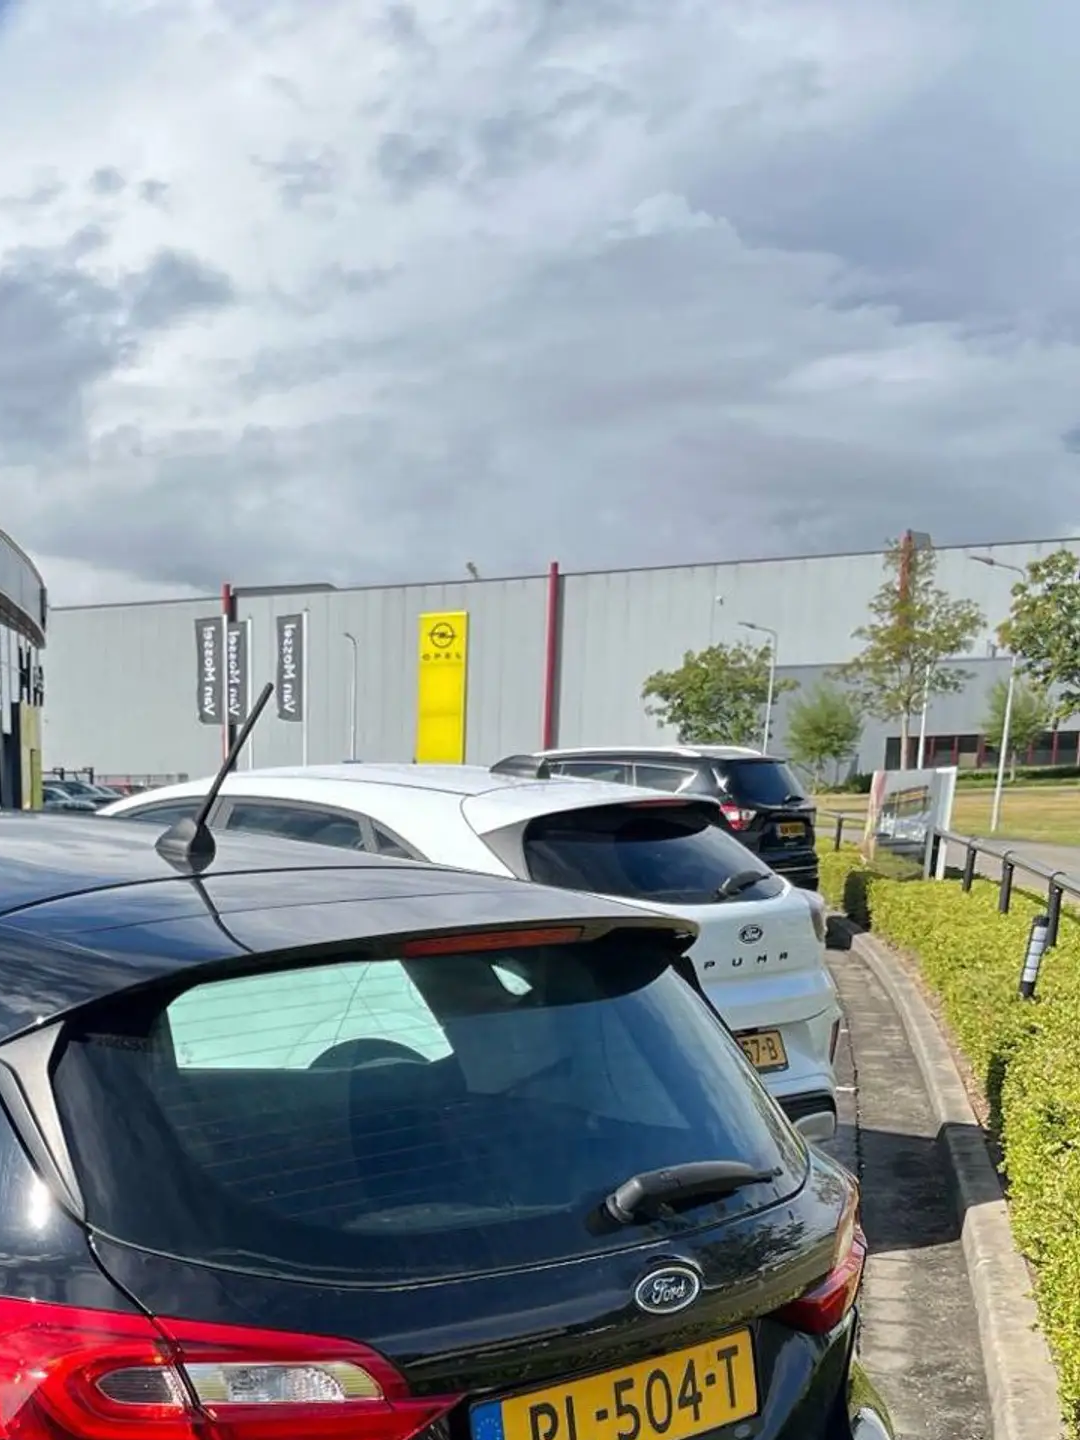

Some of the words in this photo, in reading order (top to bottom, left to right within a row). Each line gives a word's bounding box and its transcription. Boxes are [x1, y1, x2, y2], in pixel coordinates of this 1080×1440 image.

[422, 652, 461, 661] OPEL
[704, 952, 789, 971] PUMA
[651, 1276, 686, 1304] Ford
